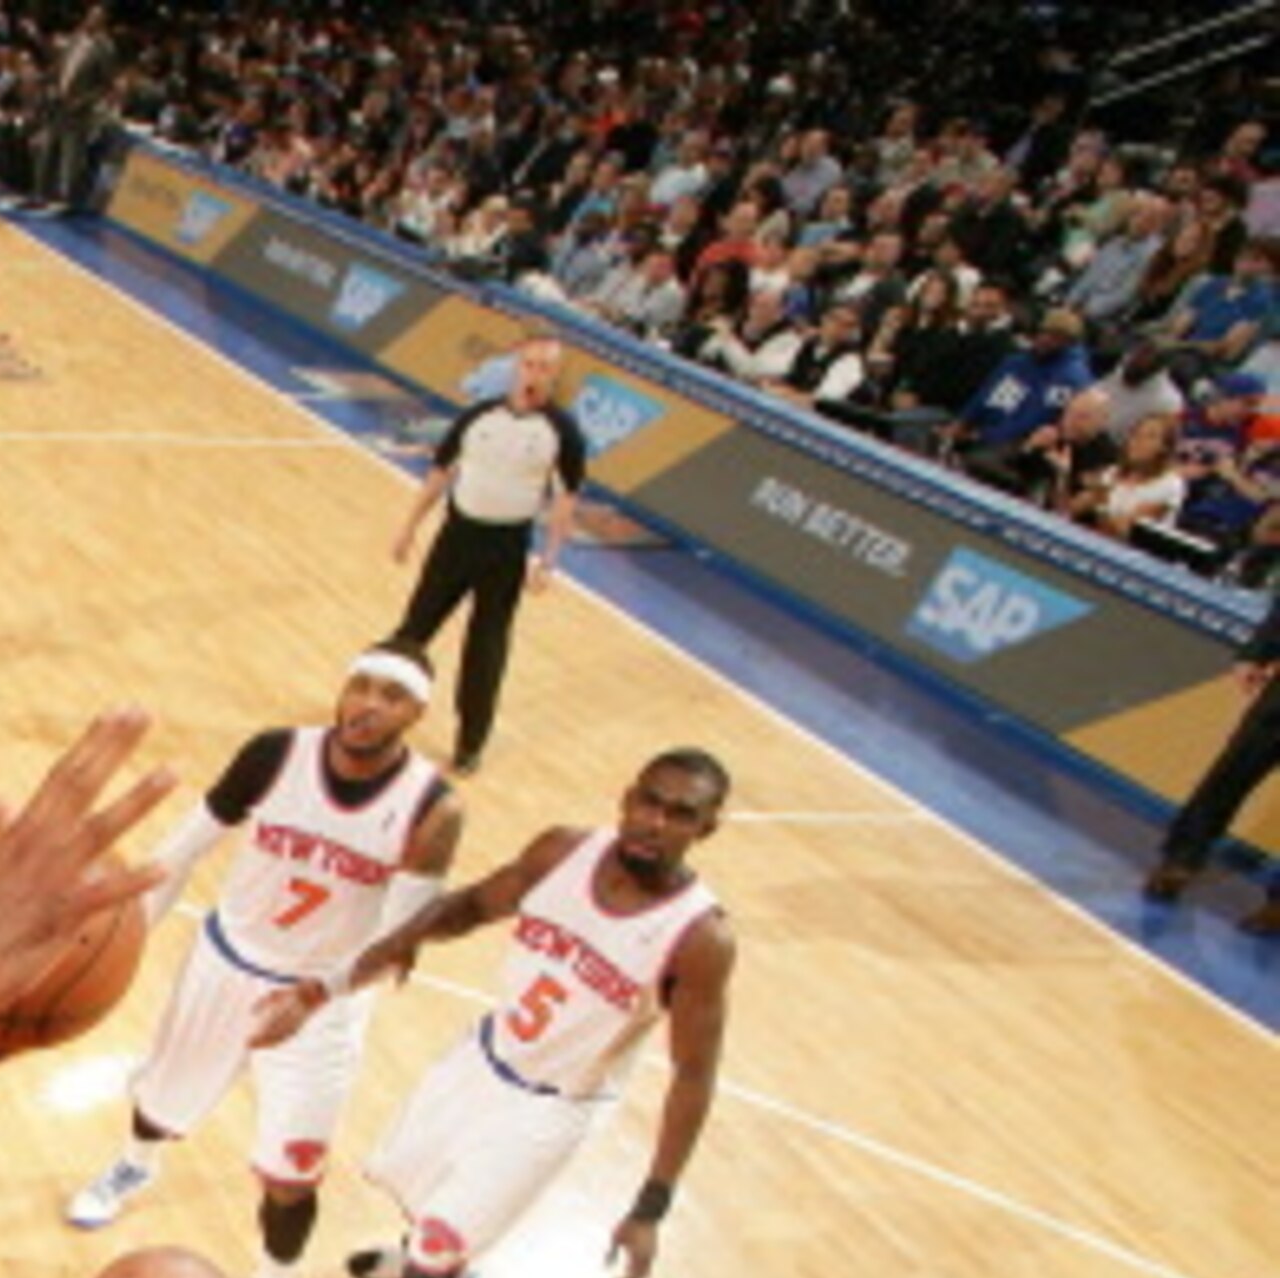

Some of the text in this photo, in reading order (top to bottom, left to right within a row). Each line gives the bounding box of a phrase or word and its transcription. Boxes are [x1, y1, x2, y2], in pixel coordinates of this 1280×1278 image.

[916, 566, 1041, 652] SAP
[271, 877, 332, 929] 7
[513, 915, 576, 961] NEW
[506, 974, 567, 1043] 5
